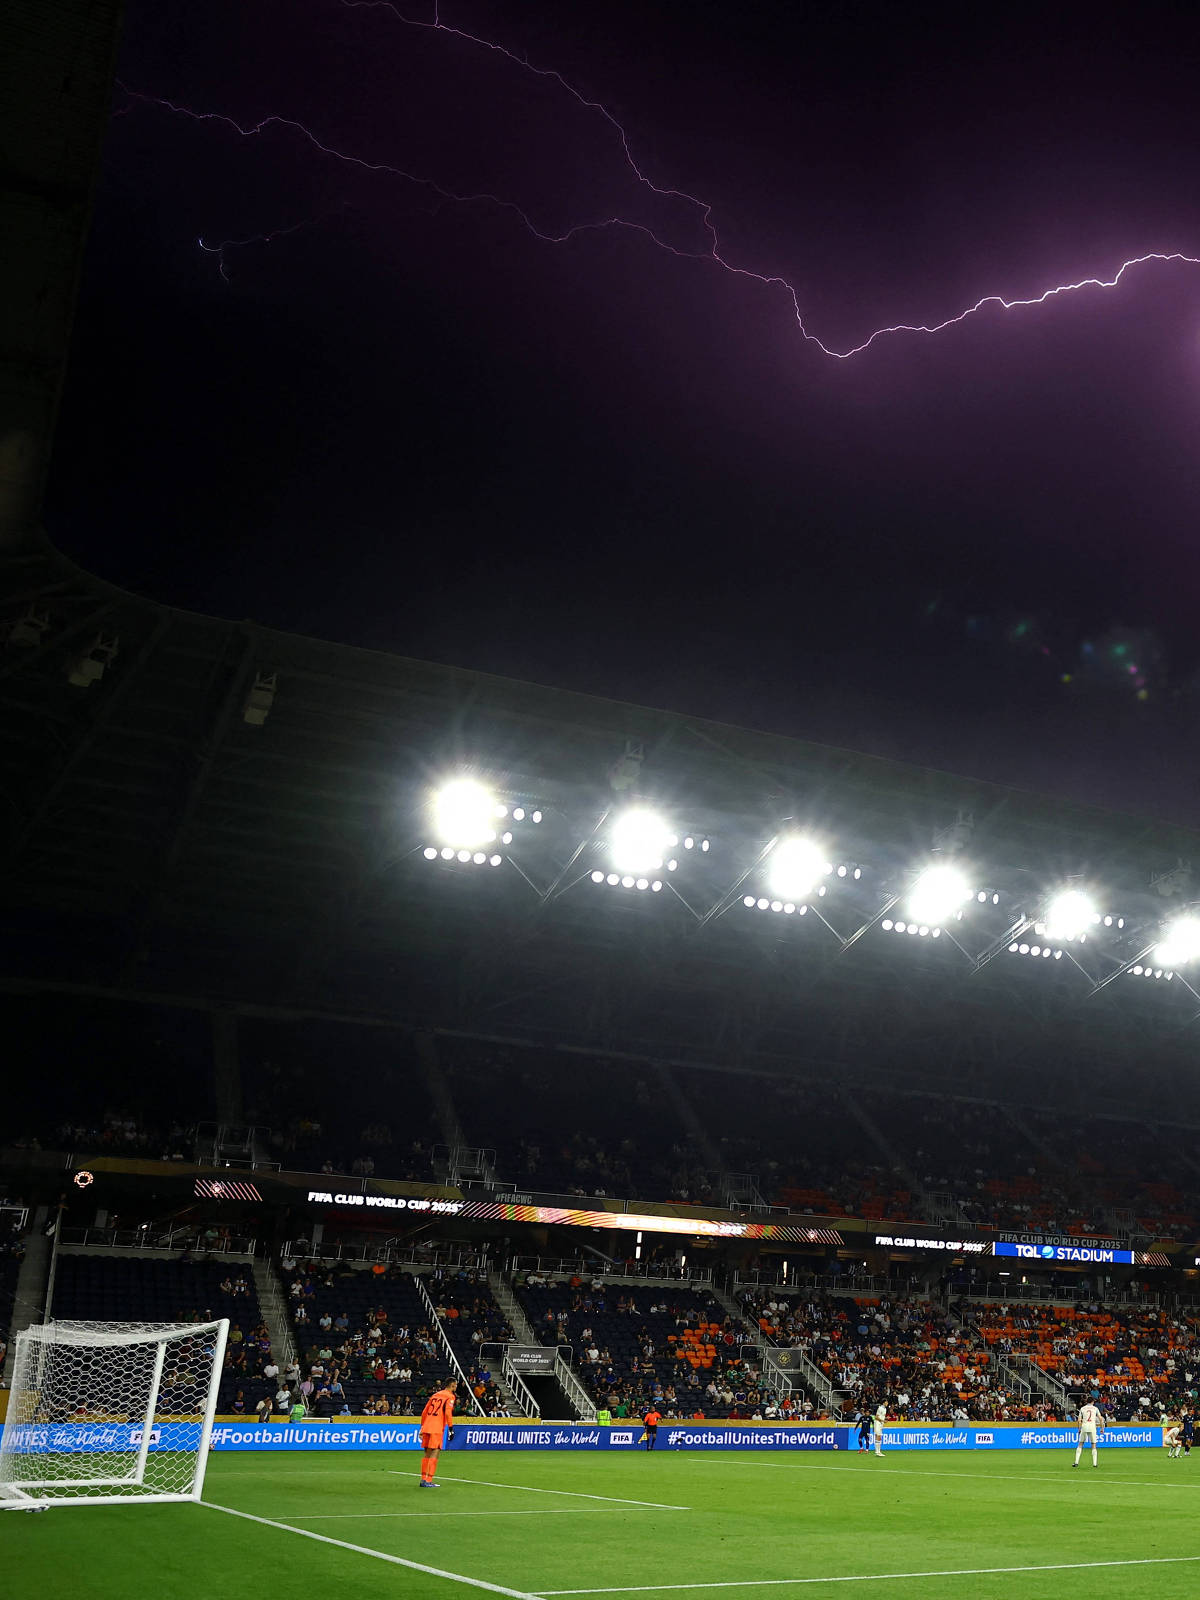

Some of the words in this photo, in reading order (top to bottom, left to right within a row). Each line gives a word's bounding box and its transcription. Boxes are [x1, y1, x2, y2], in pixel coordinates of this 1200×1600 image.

[308, 1192, 333, 1204] FIFA
[334, 1194, 364, 1206] CLUB
[365, 1196, 406, 1209] WORLD
[407, 1198, 430, 1210] CUP
[875, 1236, 893, 1246] FIFA
[894, 1238, 915, 1247] CLUB
[916, 1239, 945, 1249] WORLD
[946, 1241, 962, 1251] CUP
[1000, 1233, 1019, 1243] FIFA
[1020, 1234, 1043, 1244] CLUB
[1081, 1238, 1098, 1248] CUP
[1015, 1244, 1042, 1258] TQL
[1057, 1247, 1113, 1262] STADIUM
[427, 1398, 442, 1417] 52
[1086, 1410, 1092, 1422] 2
[76, 1429, 116, 1445] World
[466, 1431, 517, 1444] FOOTBALL
[517, 1431, 550, 1445] UNITES
[554, 1431, 570, 1444] the
[571, 1431, 599, 1445] World
[612, 1434, 630, 1442] FIFA
[667, 1431, 834, 1445] #FootballUnitesTheWorld
[903, 1433, 929, 1445] UNITES
[932, 1433, 944, 1444] the
[945, 1432, 968, 1445] World
